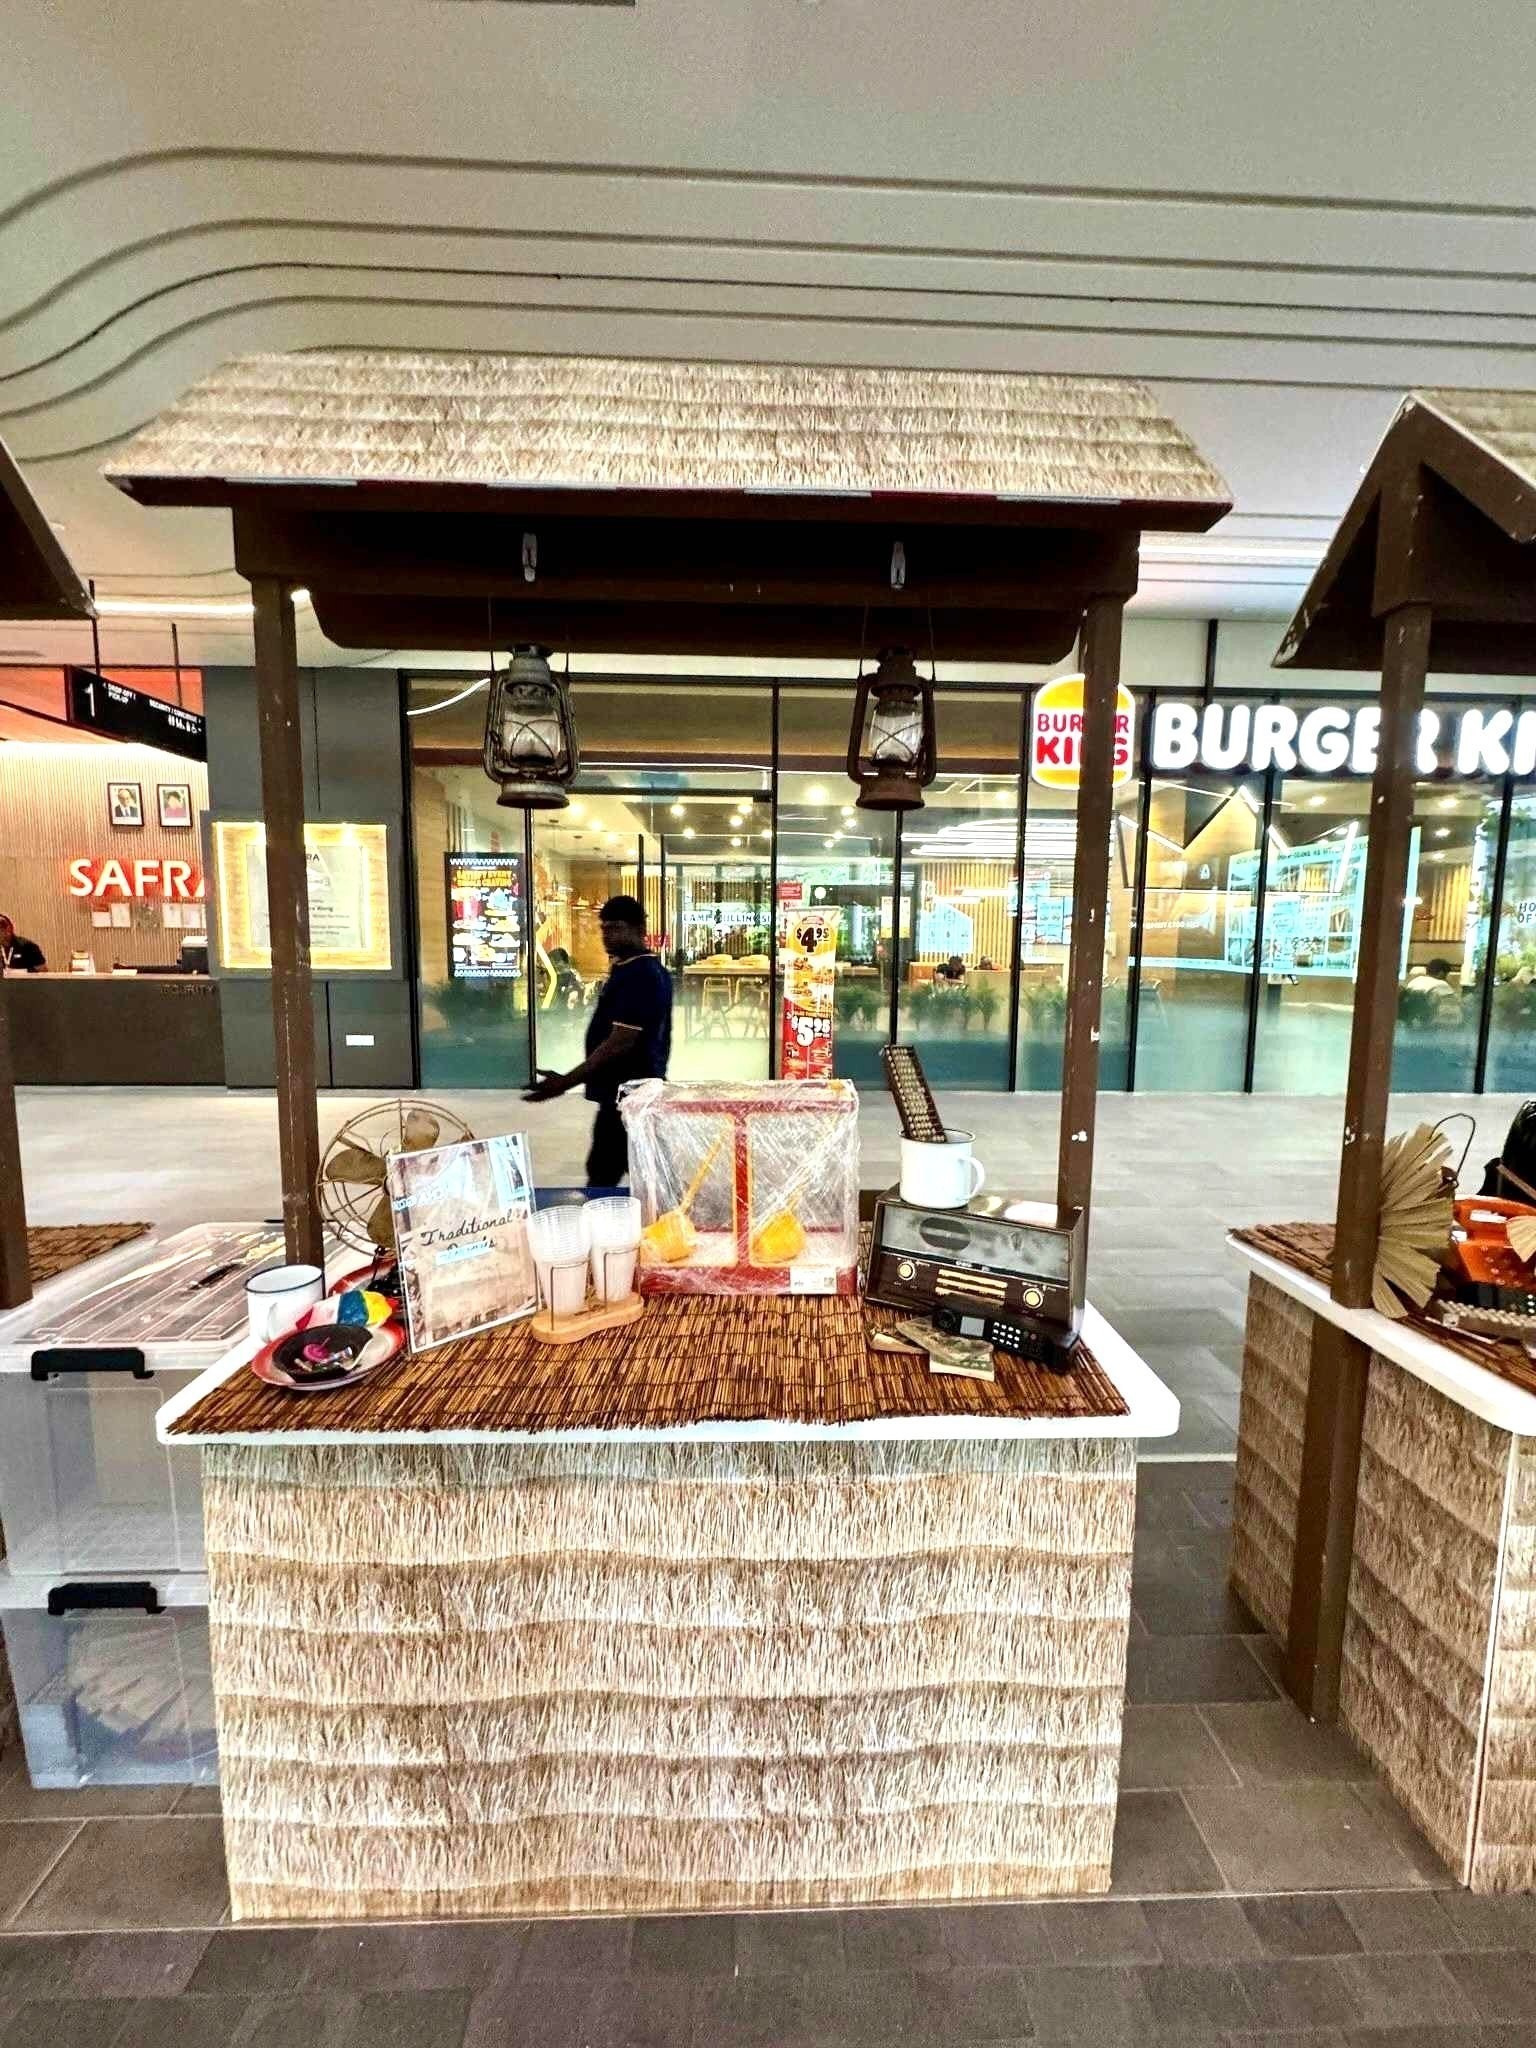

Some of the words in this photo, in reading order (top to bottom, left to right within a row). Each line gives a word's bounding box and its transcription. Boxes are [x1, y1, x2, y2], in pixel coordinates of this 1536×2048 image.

[85, 683, 95, 717] 1
[1037, 713, 1129, 733] BURR
[1036, 736, 1128, 765] KIG
[420, 1208, 512, 1247] Traditional
